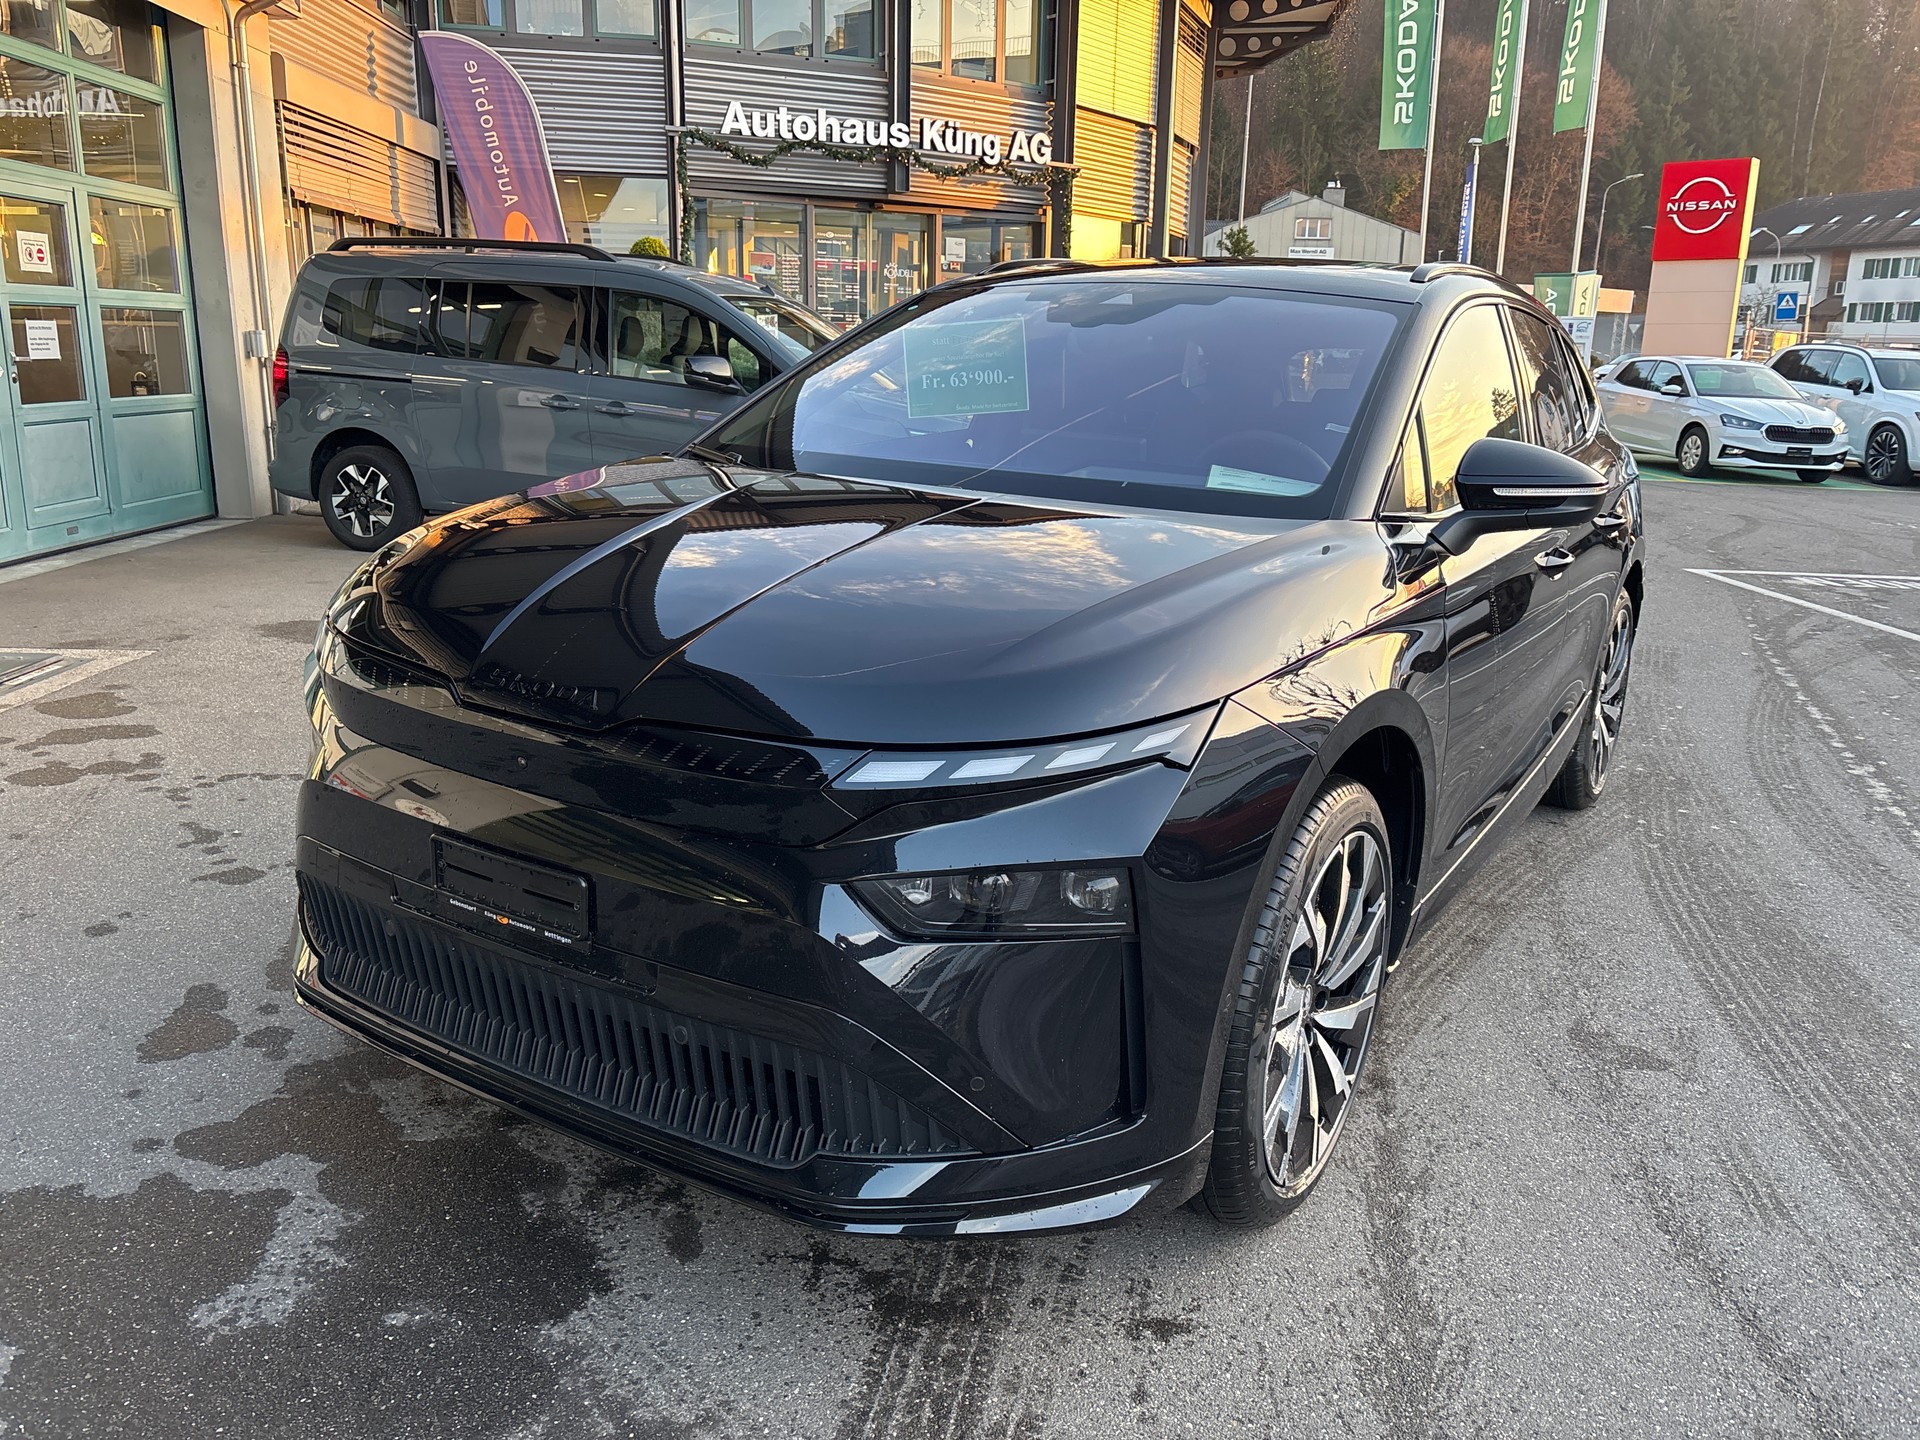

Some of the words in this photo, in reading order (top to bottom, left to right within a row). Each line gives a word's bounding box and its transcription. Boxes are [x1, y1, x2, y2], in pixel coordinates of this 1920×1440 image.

[720, 100, 911, 148] Autohaus
[921, 117, 1001, 166] Küng
[1009, 130, 1053, 165] AG
[1666, 199, 1737, 212] NISSAN
[922, 374, 945, 389] Fr.
[544, 929, 572, 945] Wettingen
